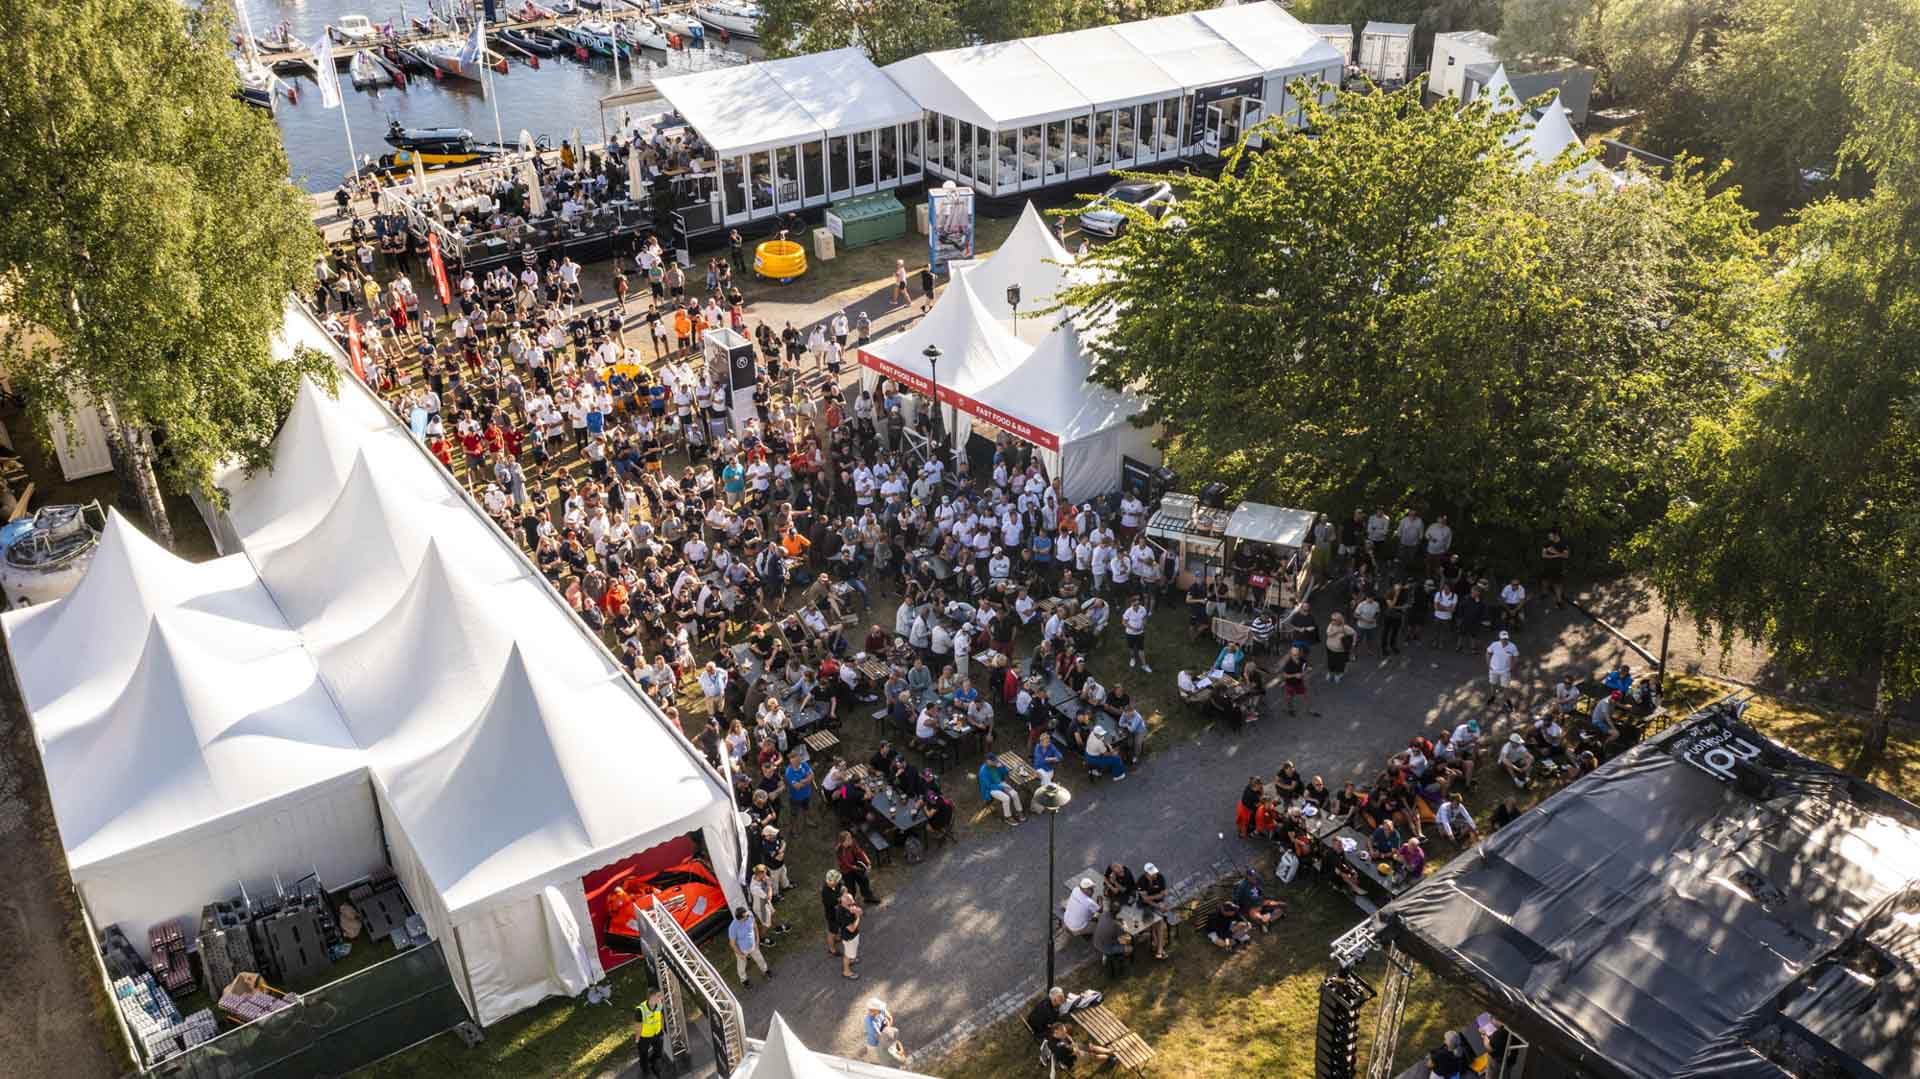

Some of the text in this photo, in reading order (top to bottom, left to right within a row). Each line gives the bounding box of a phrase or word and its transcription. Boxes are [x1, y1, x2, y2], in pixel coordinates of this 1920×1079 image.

[880, 362, 893, 374] FAST
[893, 367, 910, 381] FOOD
[916, 379, 928, 389] BAR
[976, 406, 1032, 435] FAST FOOD & BAR
[1689, 728, 1733, 755] prodtion
